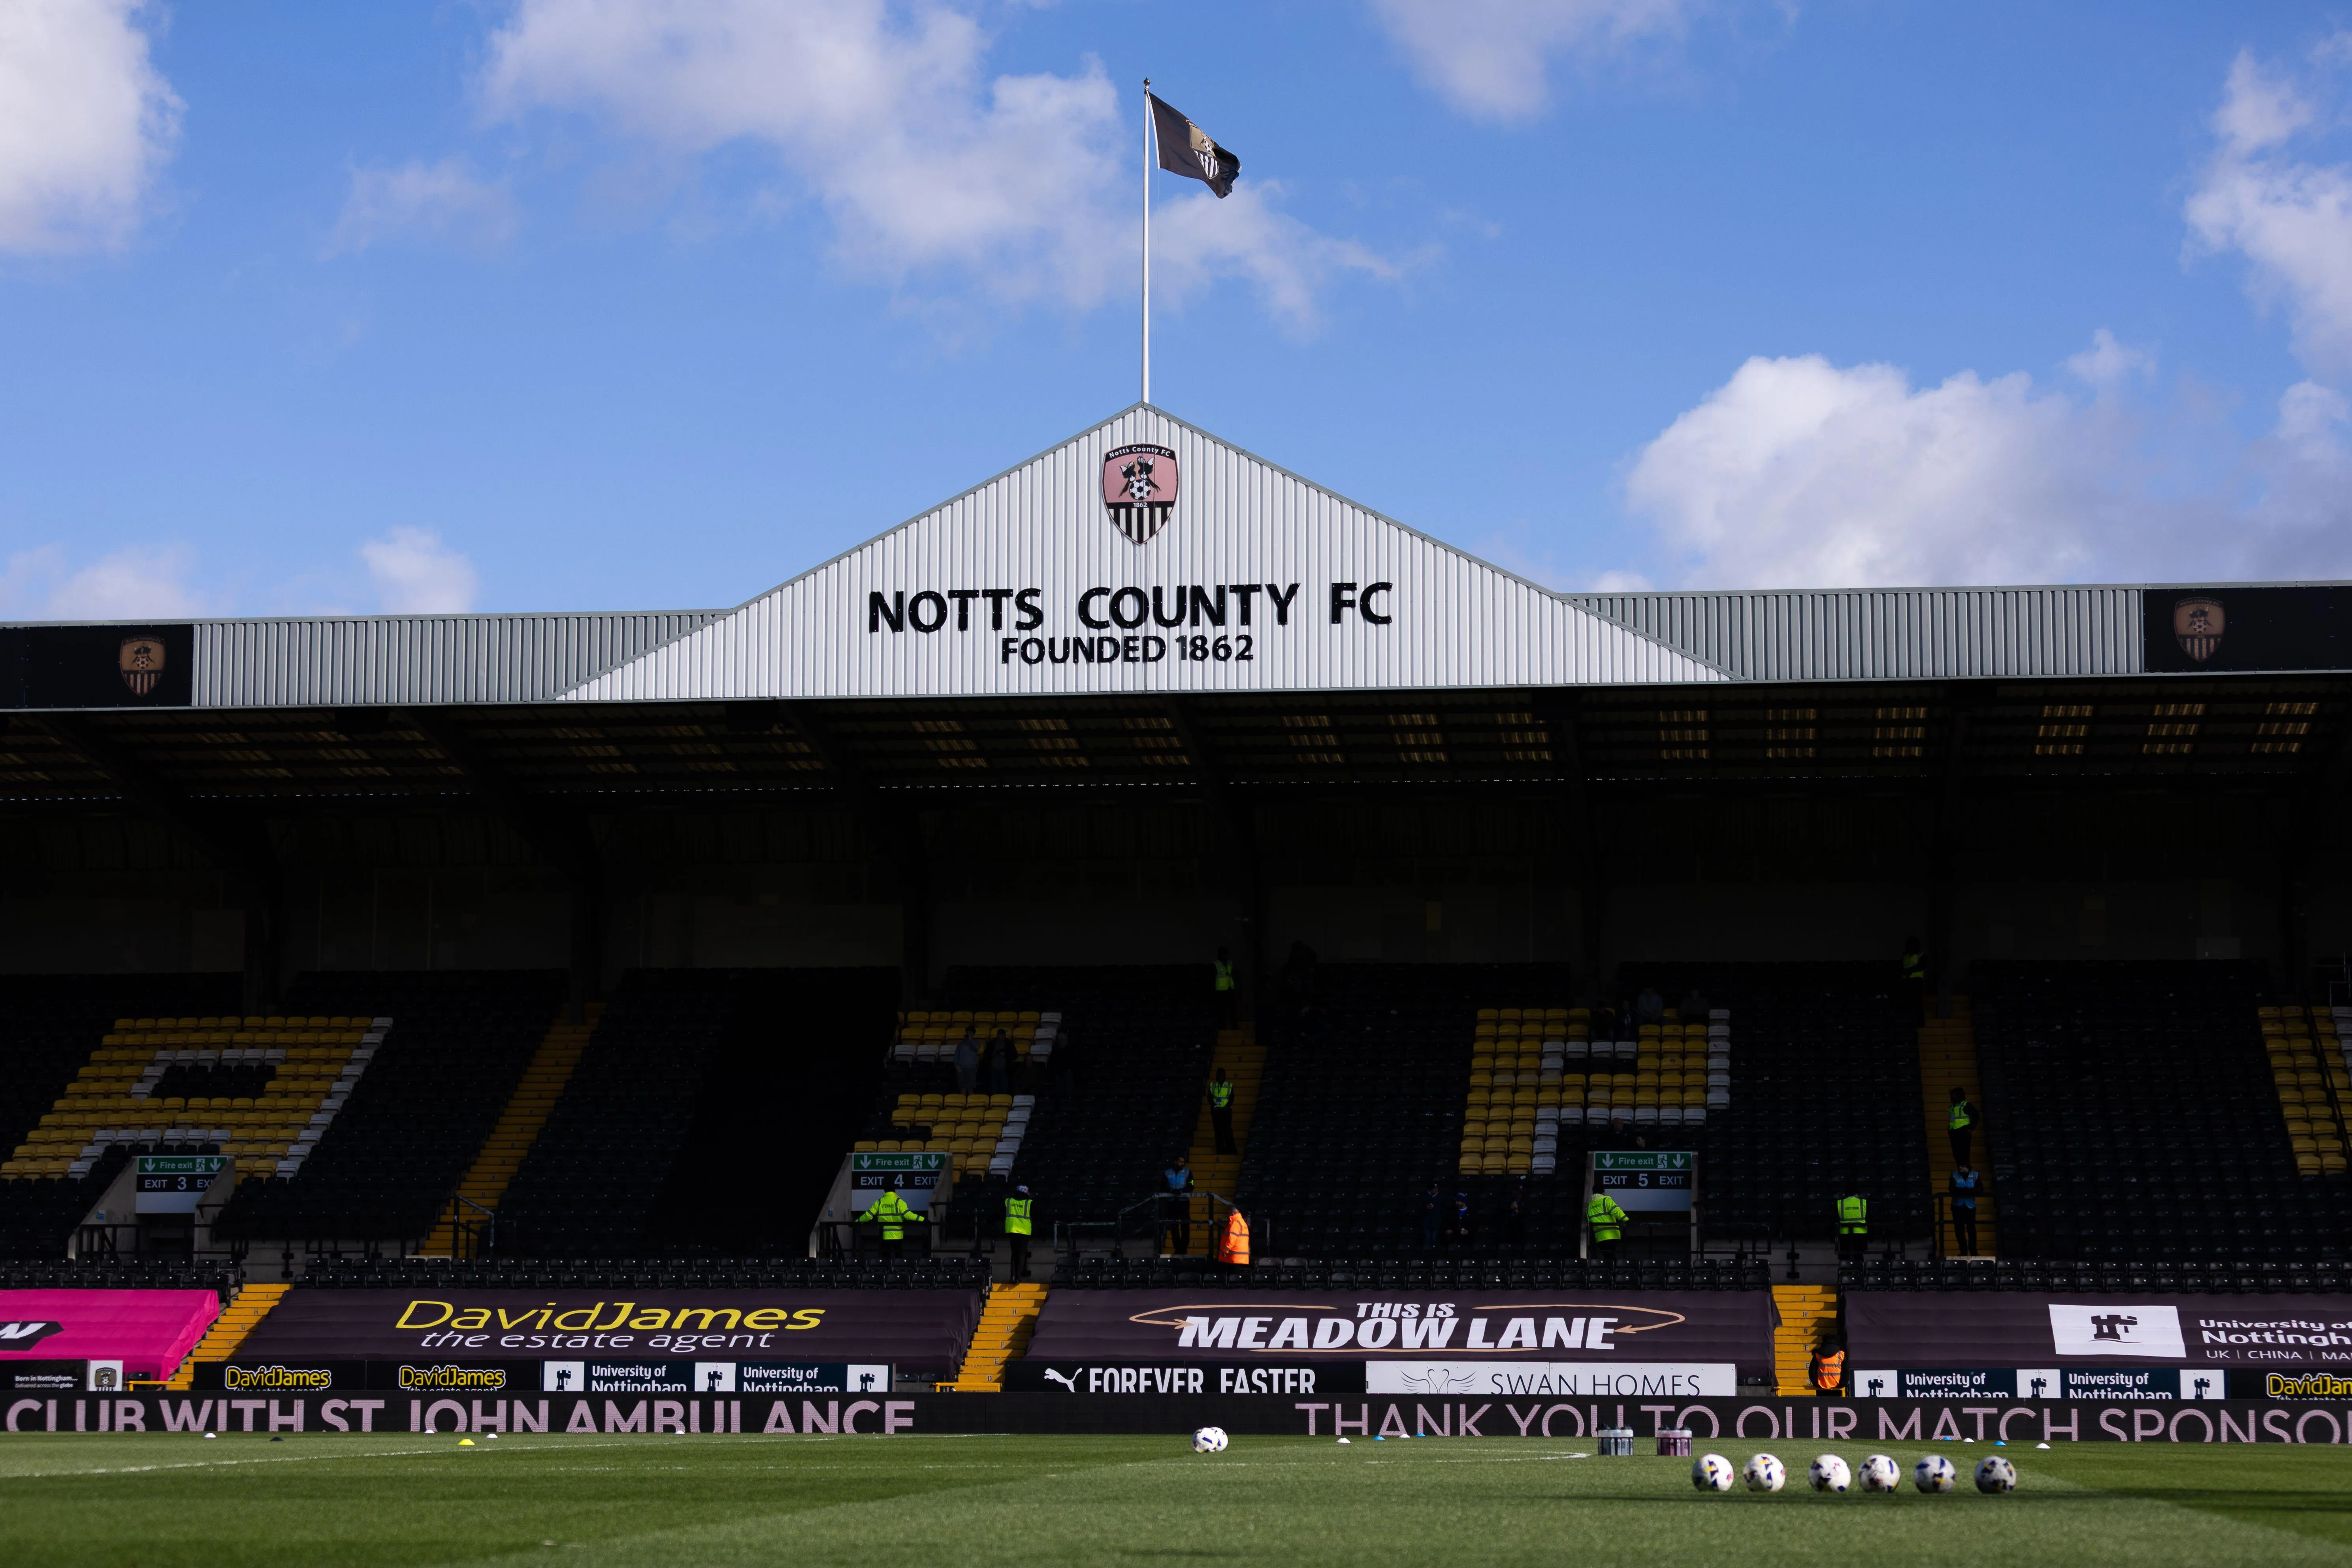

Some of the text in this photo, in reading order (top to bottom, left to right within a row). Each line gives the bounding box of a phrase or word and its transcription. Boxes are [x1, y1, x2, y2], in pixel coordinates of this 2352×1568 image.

[1109, 447, 1129, 458] Notts
[869, 582, 1393, 632] NOTTS COUNTY FC
[1001, 634, 1253, 664] FOUNDED 1862
[145, 1180, 168, 1188] EXIT
[178, 1177, 186, 1190] 3
[861, 1174, 939, 1187] EXIT 4 EXIT
[1603, 1173, 1683, 1187] EXIT 5 EXIT
[395, 1301, 825, 1330] DavidJames
[1357, 1303, 1456, 1318] THIS IS
[1178, 1316, 1618, 1350] MEADOW LANE
[2199, 1320, 2325, 1331] University
[421, 1331, 775, 1353] the estate agent
[2201, 1330, 2352, 1346] Nottingh
[2206, 1350, 2352, 1360] UK CHINA MA
[228, 1369, 329, 1386] DavidJames
[402, 1368, 503, 1385] DavidJames
[592, 1365, 666, 1380] University of
[744, 1367, 819, 1382] University of
[1906, 1373, 1986, 1387] University of
[2069, 1373, 2149, 1387] University of
[1491, 1373, 1700, 1396] SWAN HOMES
[159, 1399, 305, 1432] WITH
[321, 1399, 385, 1432] ST
[1295, 1403, 2352, 1444] THANK YOU TO OUR MATCH SPONSO
